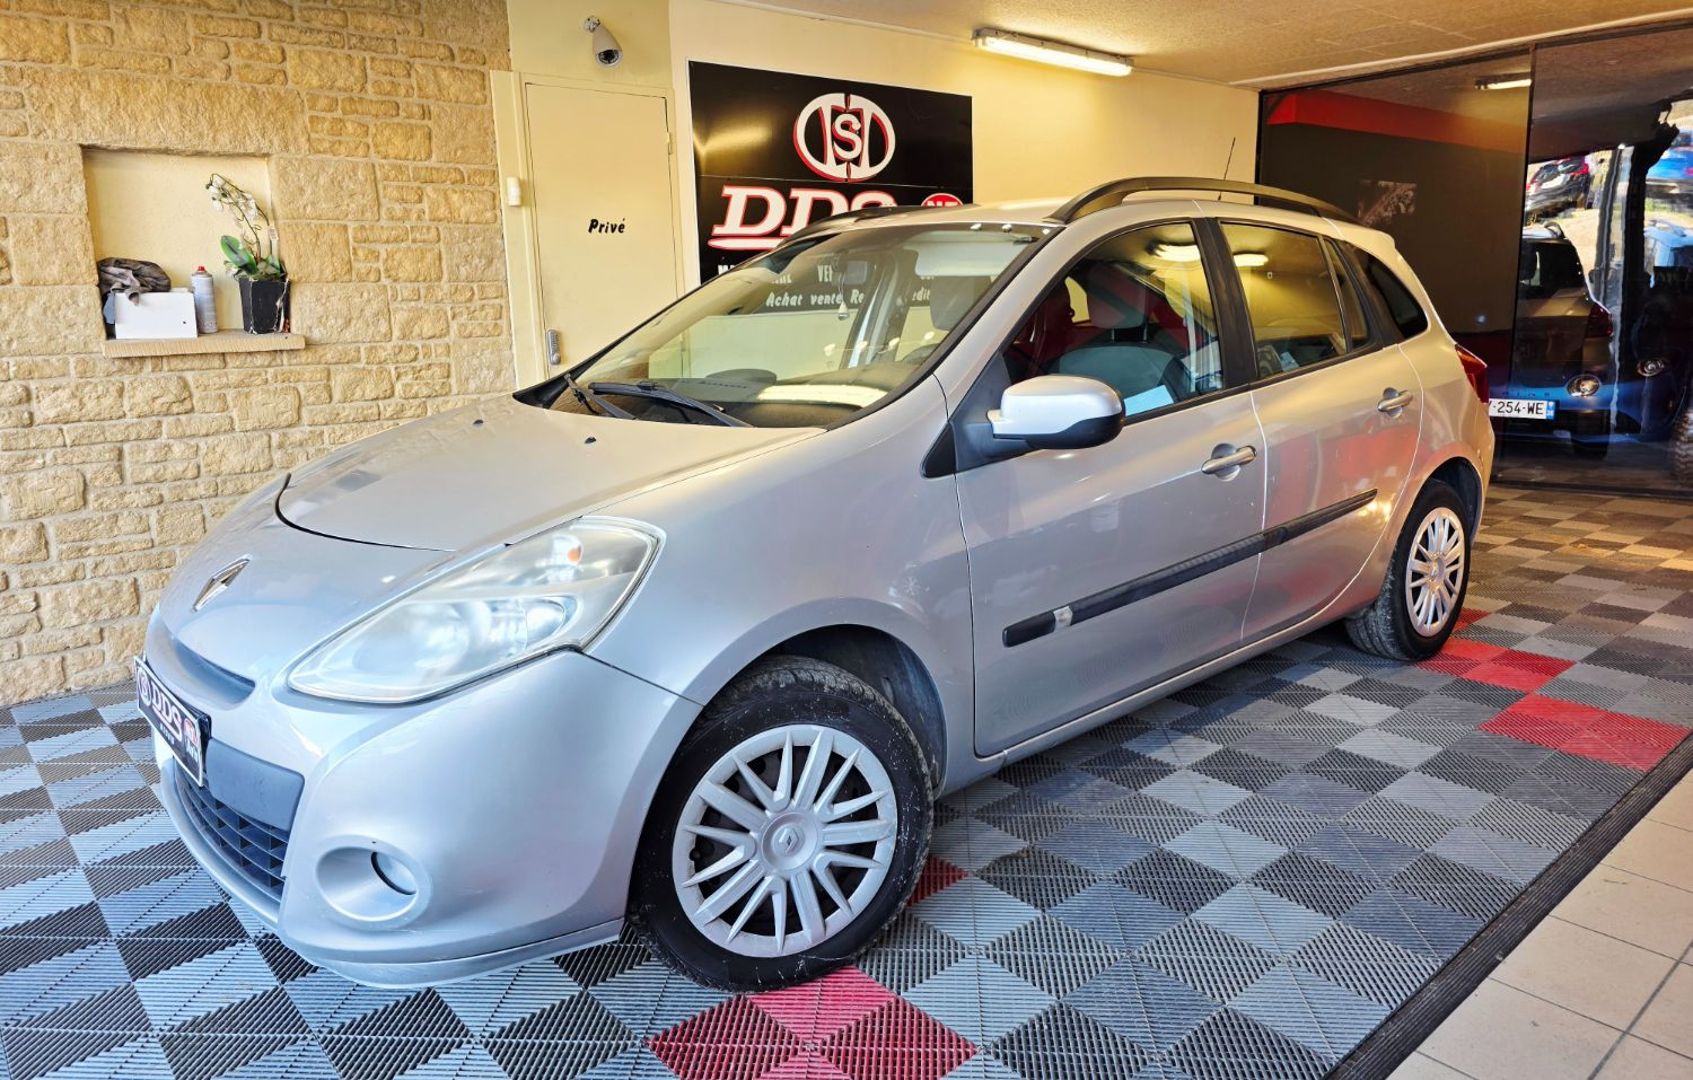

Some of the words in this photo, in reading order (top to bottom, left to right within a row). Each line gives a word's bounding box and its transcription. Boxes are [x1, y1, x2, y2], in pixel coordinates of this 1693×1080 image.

[588, 217, 625, 234] Privé
[766, 289, 802, 307] Achat
[810, 291, 844, 306] vente
[1489, 400, 1545, 415] -254-WE
[150, 680, 182, 742] DDS
